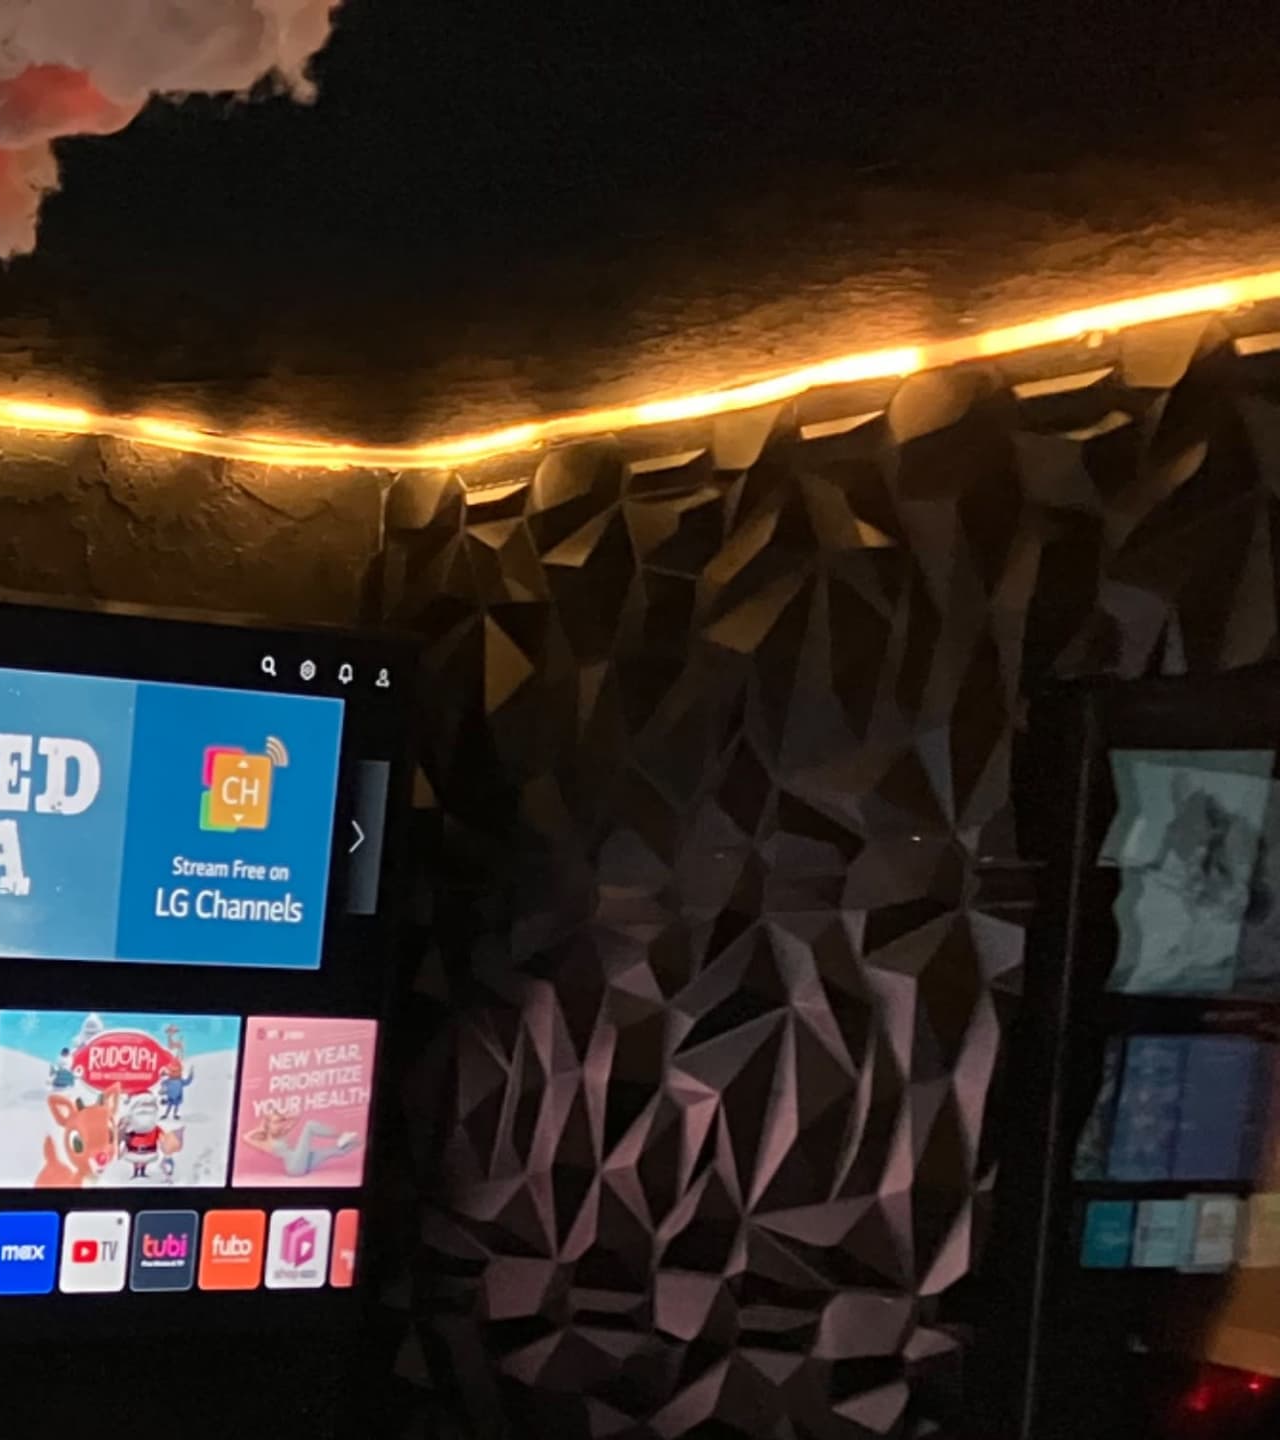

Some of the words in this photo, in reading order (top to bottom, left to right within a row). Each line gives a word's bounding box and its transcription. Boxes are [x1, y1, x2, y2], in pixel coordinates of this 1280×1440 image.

[221, 776, 259, 805] CH
[173, 857, 229, 880] Stream
[233, 860, 265, 880] Free
[270, 866, 289, 881] on
[156, 888, 189, 918] LG
[195, 890, 302, 922] Channels
[88, 1046, 157, 1072] RUDOLPH
[269, 1049, 310, 1072] NEW
[269, 1065, 362, 1093] PRIORITIZE
[252, 1095, 301, 1117] YOUR
[304, 1087, 369, 1111] HEALTH
[1, 1244, 45, 1261] max
[101, 1241, 119, 1260] TV
[142, 1234, 188, 1258] tubi
[211, 1234, 253, 1256] fubo
